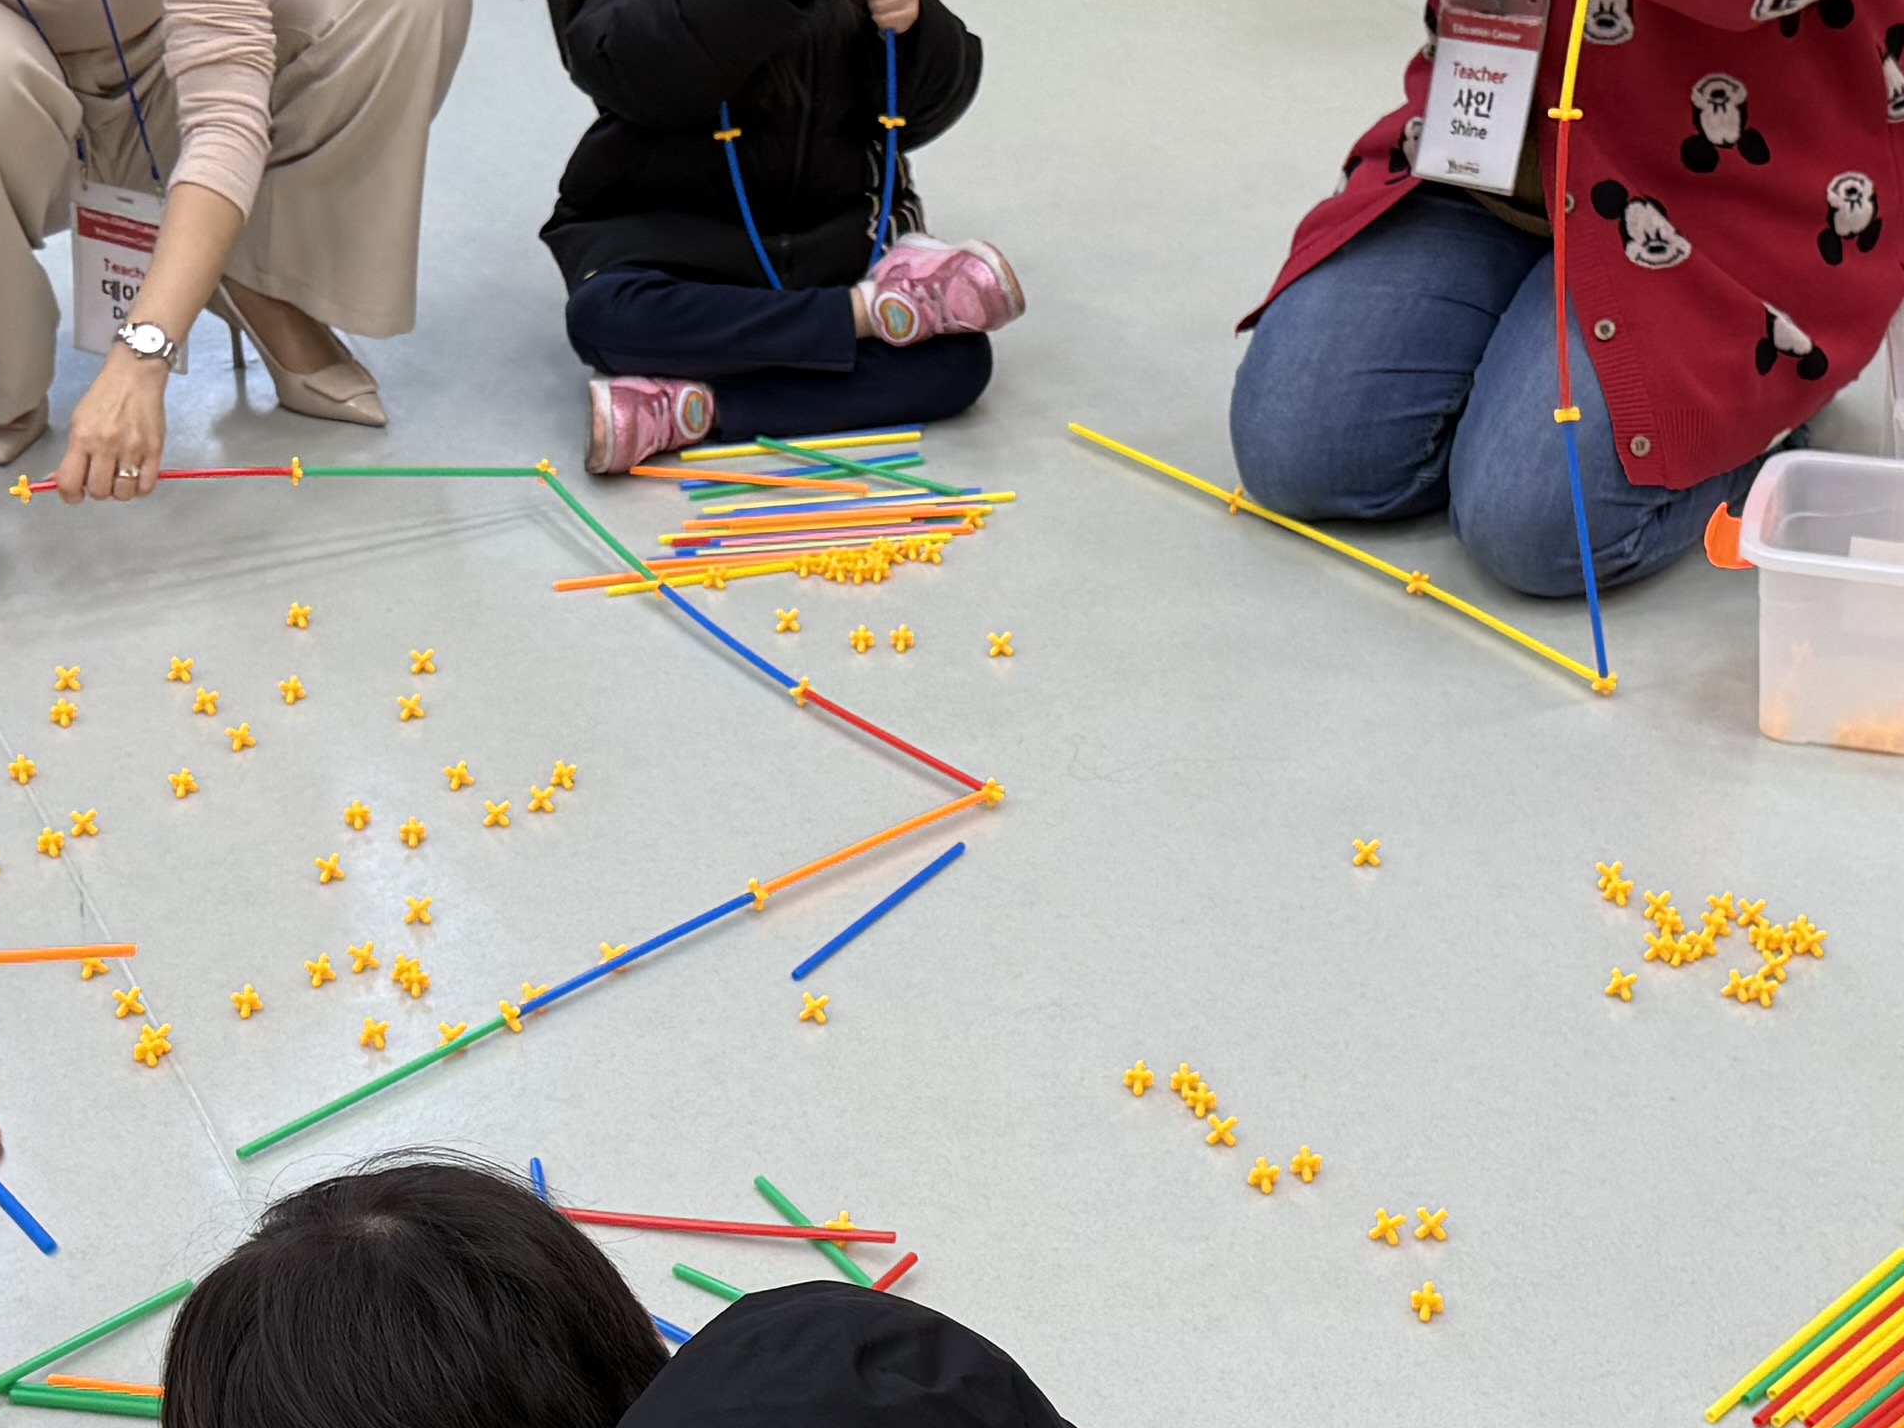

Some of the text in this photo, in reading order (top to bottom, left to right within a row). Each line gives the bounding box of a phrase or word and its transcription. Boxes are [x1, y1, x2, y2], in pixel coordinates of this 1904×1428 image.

[1453, 62, 1508, 85] Teacher
[1453, 88, 1493, 119] 샤인
[1450, 120, 1488, 140] Shine
